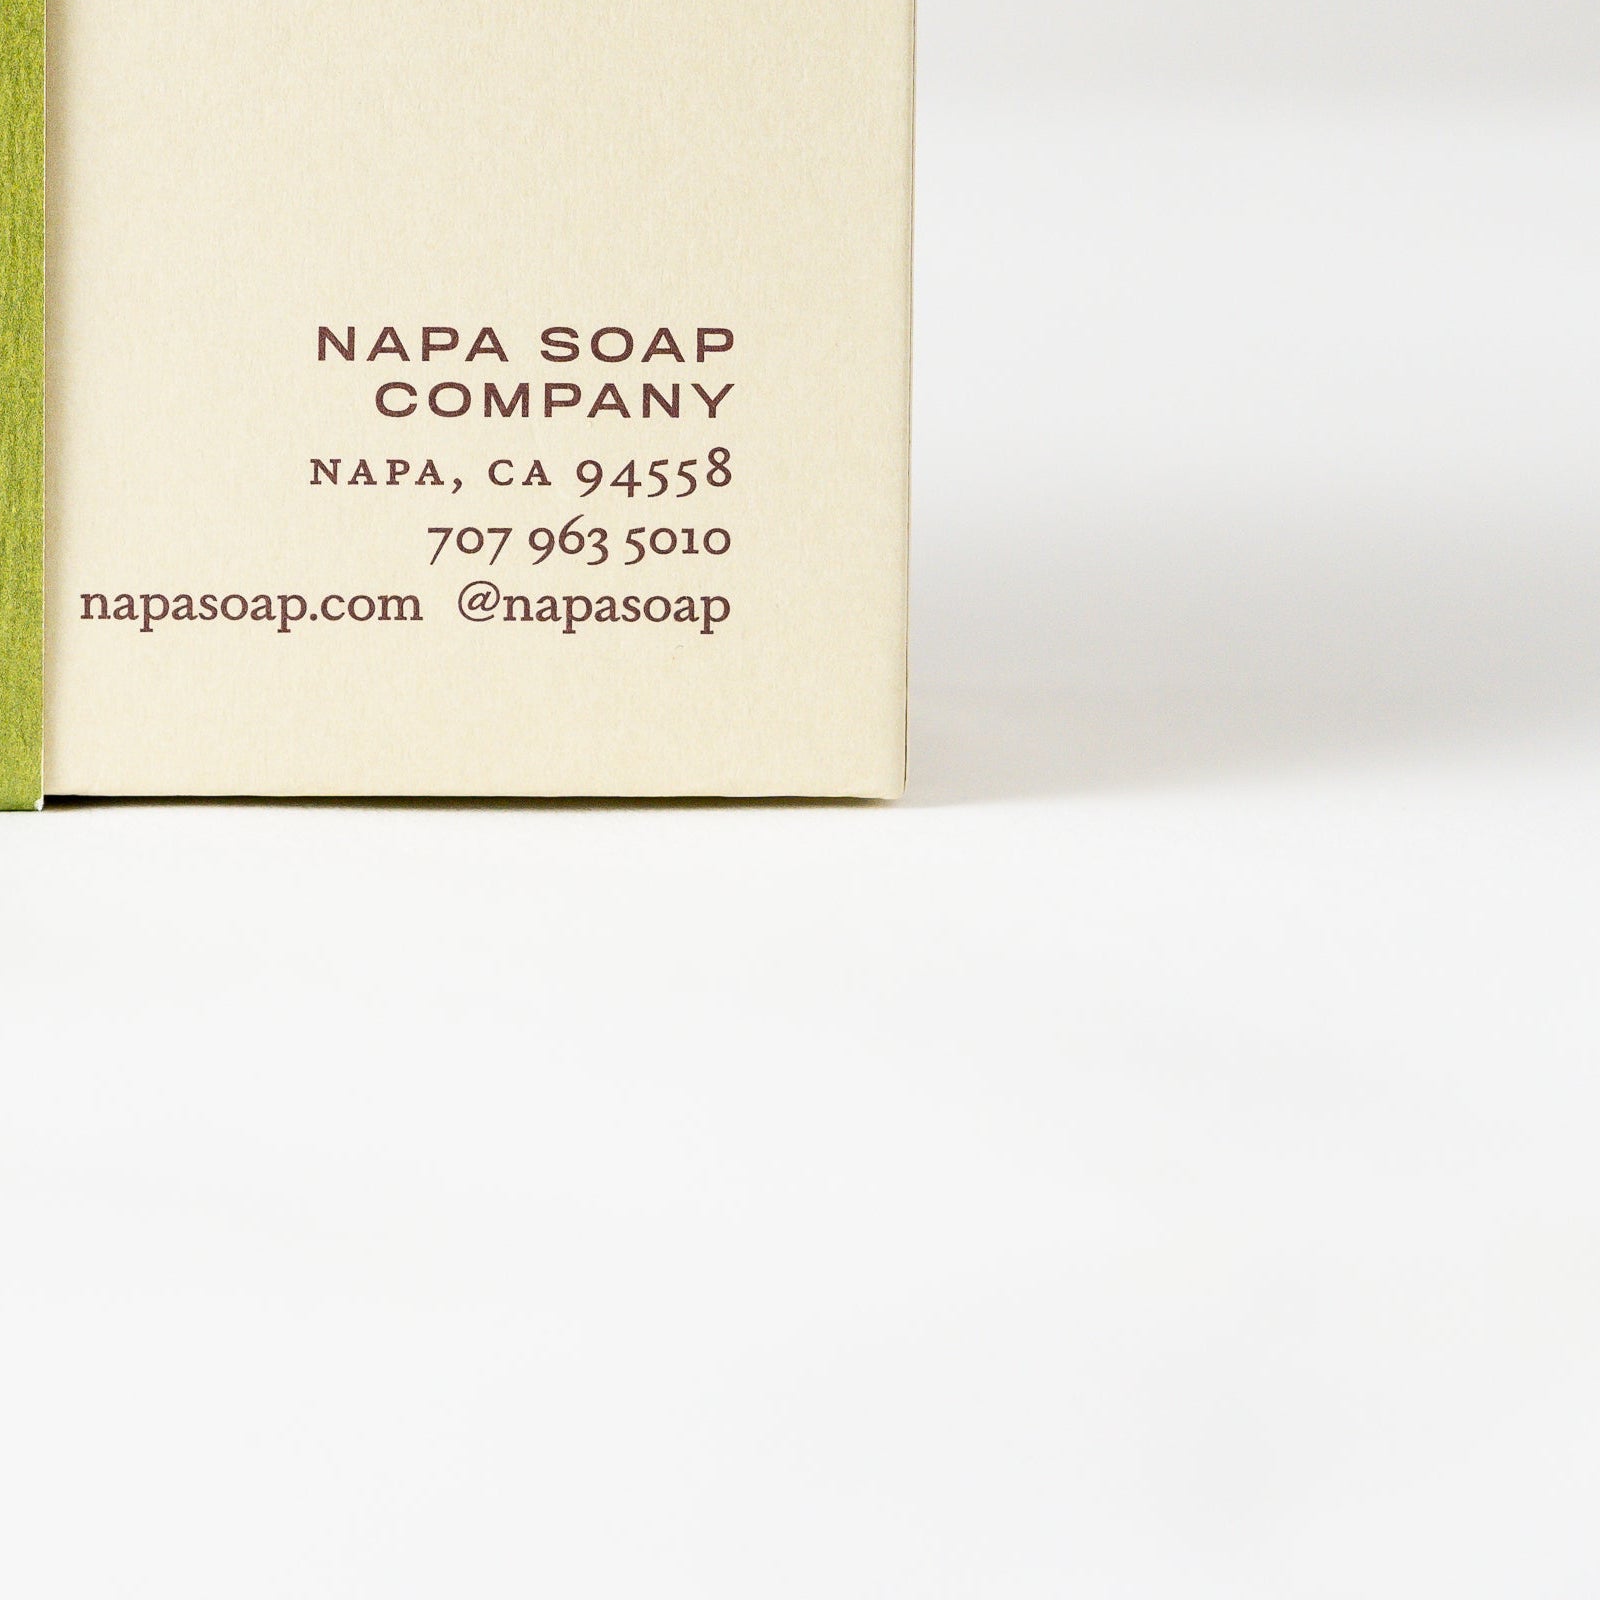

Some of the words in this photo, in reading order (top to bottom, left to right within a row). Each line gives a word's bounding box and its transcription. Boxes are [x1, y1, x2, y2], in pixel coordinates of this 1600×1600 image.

[318, 326, 509, 362] NAPA
[541, 327, 734, 362] SOAP
[376, 382, 735, 418] COMPANY
[310, 459, 462, 494] NAPA,
[488, 460, 551, 486] CA
[577, 447, 731, 497] 94558
[428, 527, 512, 565] 707
[529, 514, 608, 565] 963
[625, 527, 730, 565] 5010
[80, 594, 423, 633] napasoap.com
[458, 581, 730, 634] @napasoap
